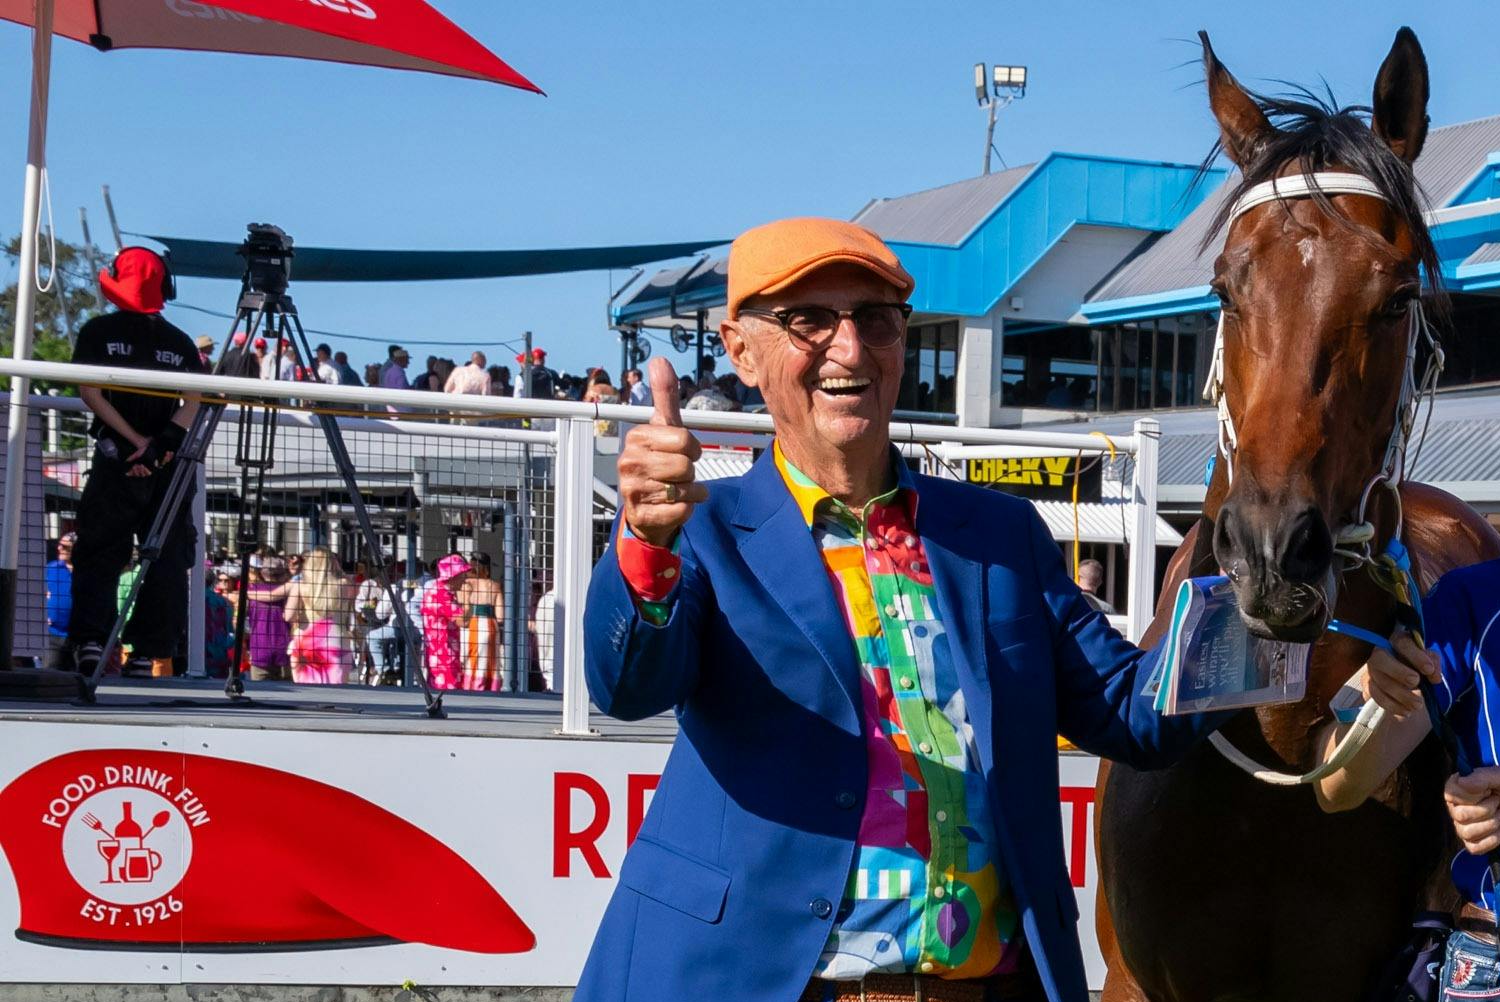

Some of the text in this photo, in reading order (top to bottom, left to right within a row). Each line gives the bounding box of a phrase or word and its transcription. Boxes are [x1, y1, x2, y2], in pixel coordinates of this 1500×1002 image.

[155, 350, 184, 366] REW
[969, 457, 1070, 486] CHEEKY
[174, 787, 211, 827] FUN
[134, 895, 183, 926] 1926
